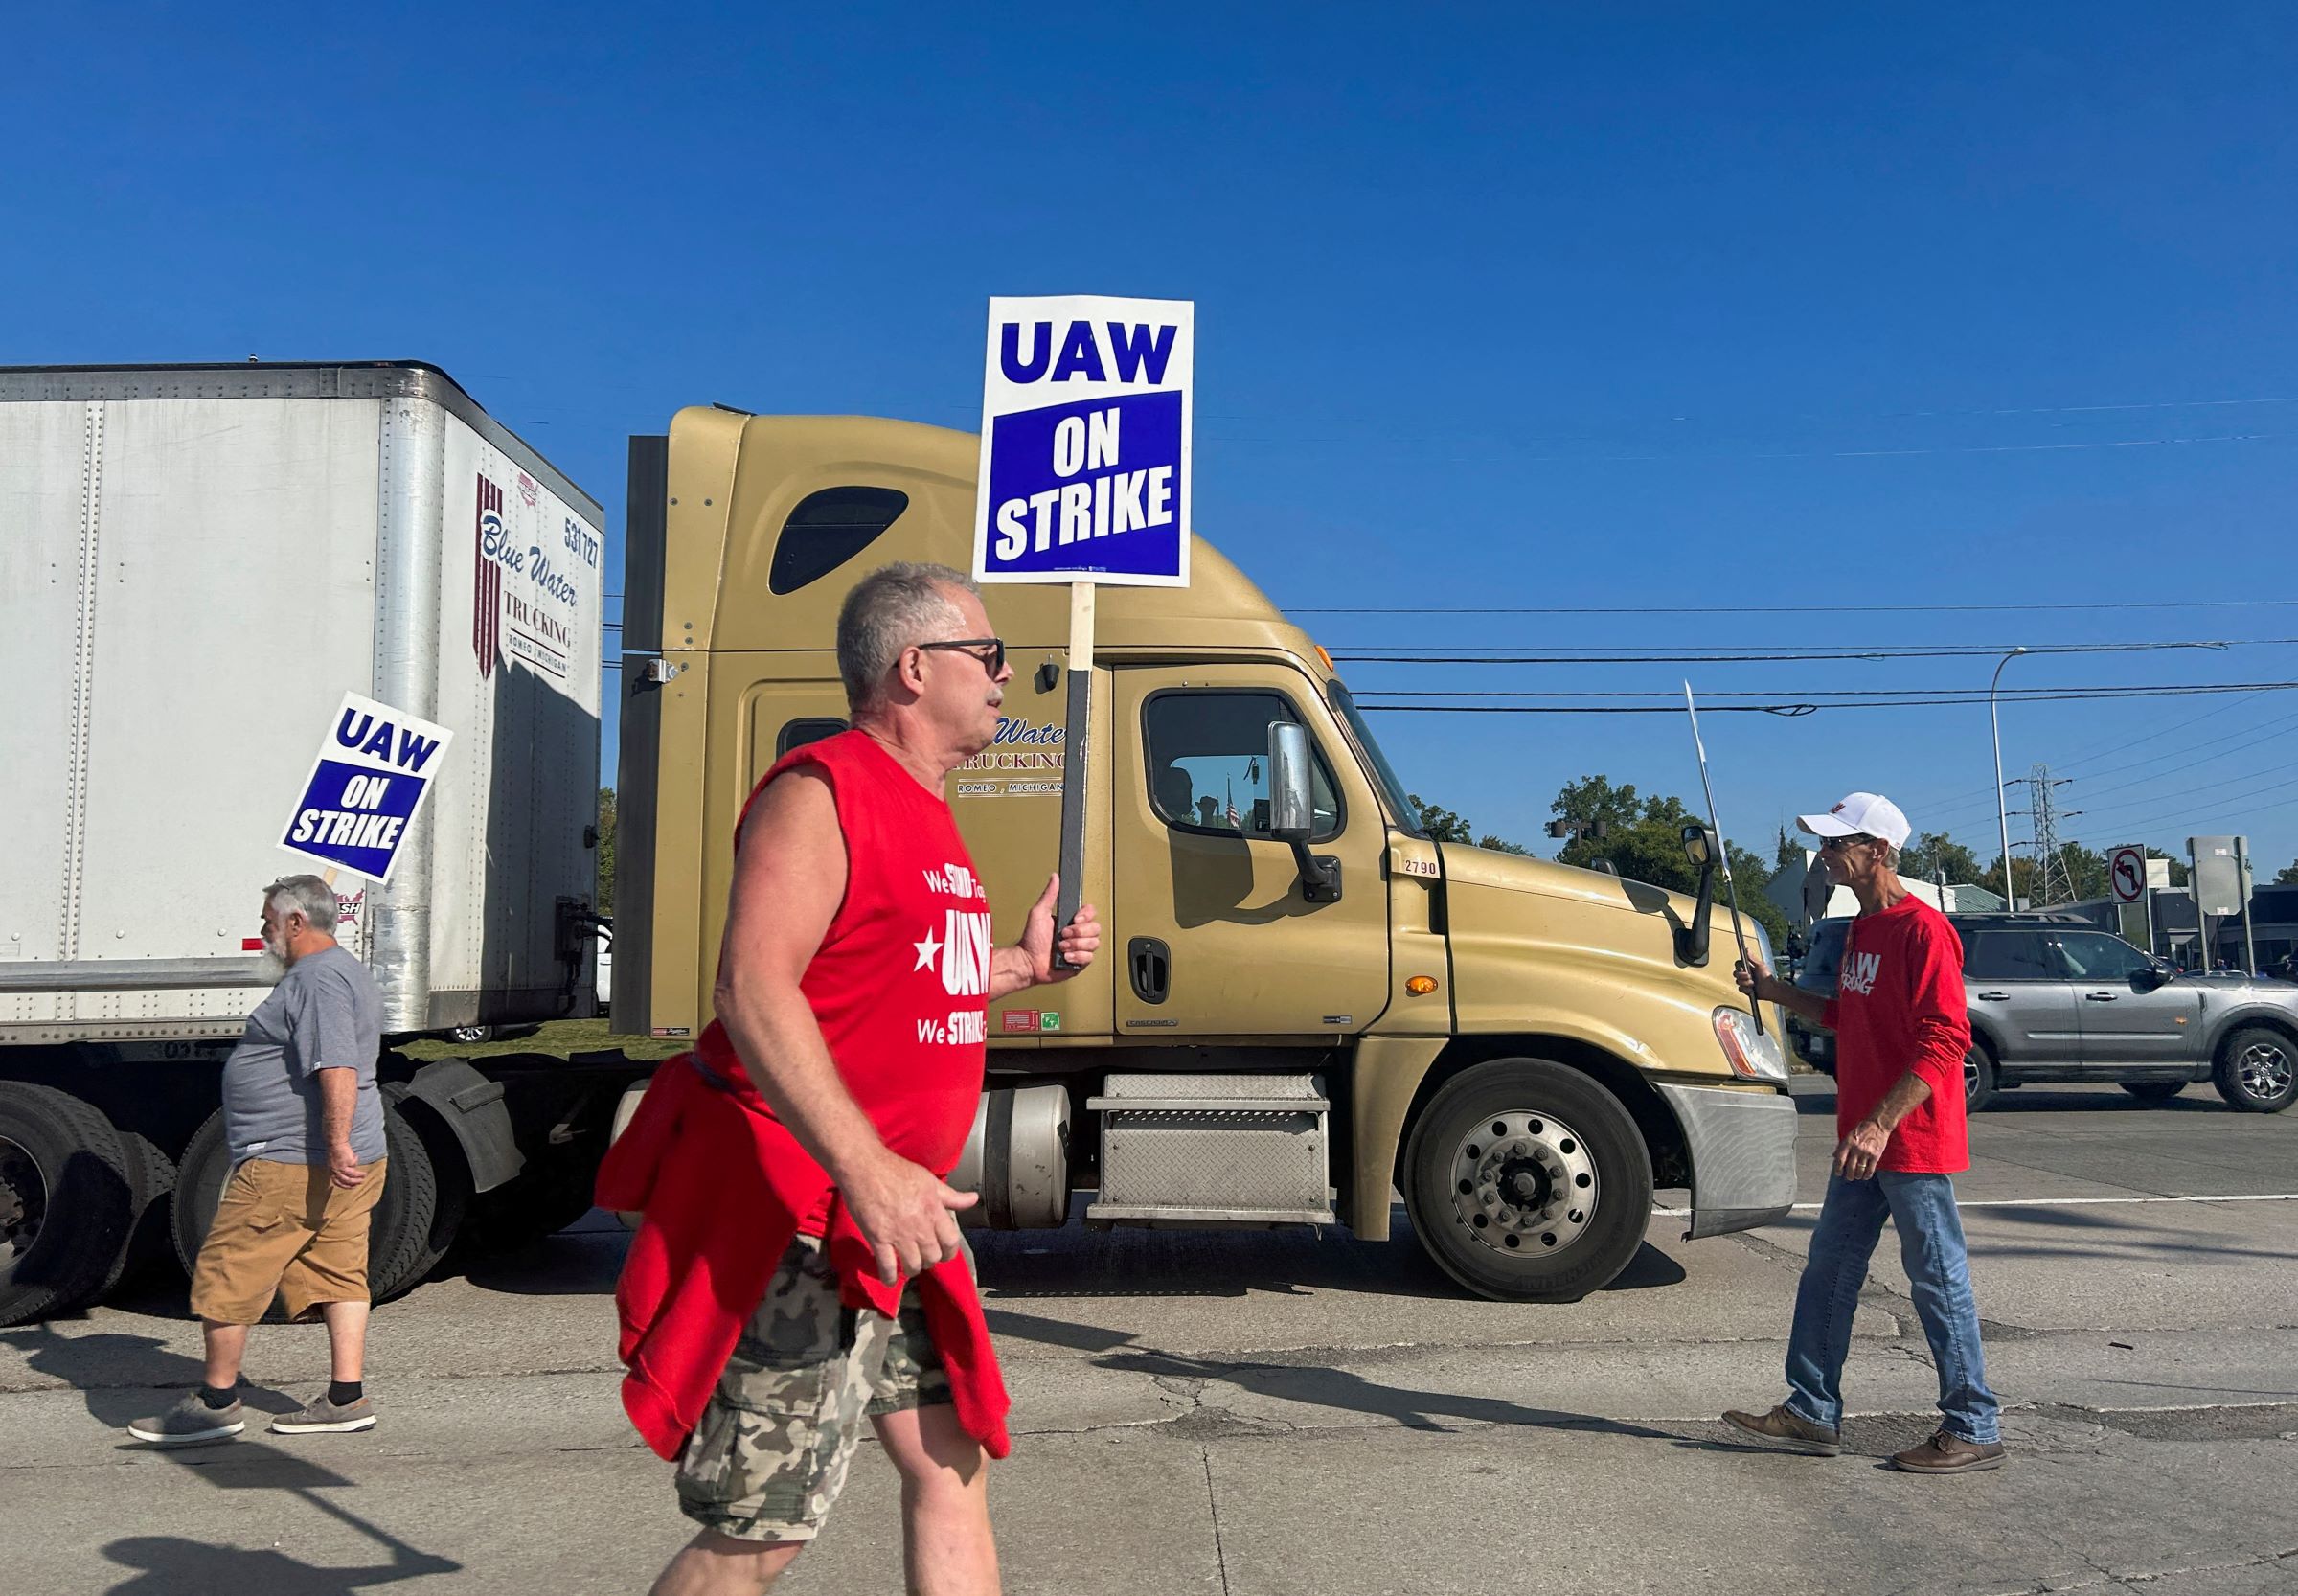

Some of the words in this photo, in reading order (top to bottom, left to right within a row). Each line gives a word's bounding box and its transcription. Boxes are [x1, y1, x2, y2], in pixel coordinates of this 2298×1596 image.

[1000, 320, 1178, 385] UAW
[1053, 407, 1121, 478] ON
[995, 465, 1172, 561] STRIKE
[483, 515, 524, 573] Blue
[529, 546, 577, 607] Water
[564, 517, 599, 569] 531727
[504, 590, 571, 648] TRUCKING
[509, 634, 532, 653] ROMEO
[336, 707, 441, 773] UAW
[993, 717, 1067, 745] Wate
[340, 774, 391, 810] ON
[957, 784, 997, 794] ROMEO
[1009, 782, 1065, 793] MICHIGAN
[291, 808, 404, 850] STRIKE
[922, 870, 950, 893] We
[1405, 859, 1436, 875] 2790
[942, 909, 991, 995] UAW
[917, 1018, 945, 1044] We
